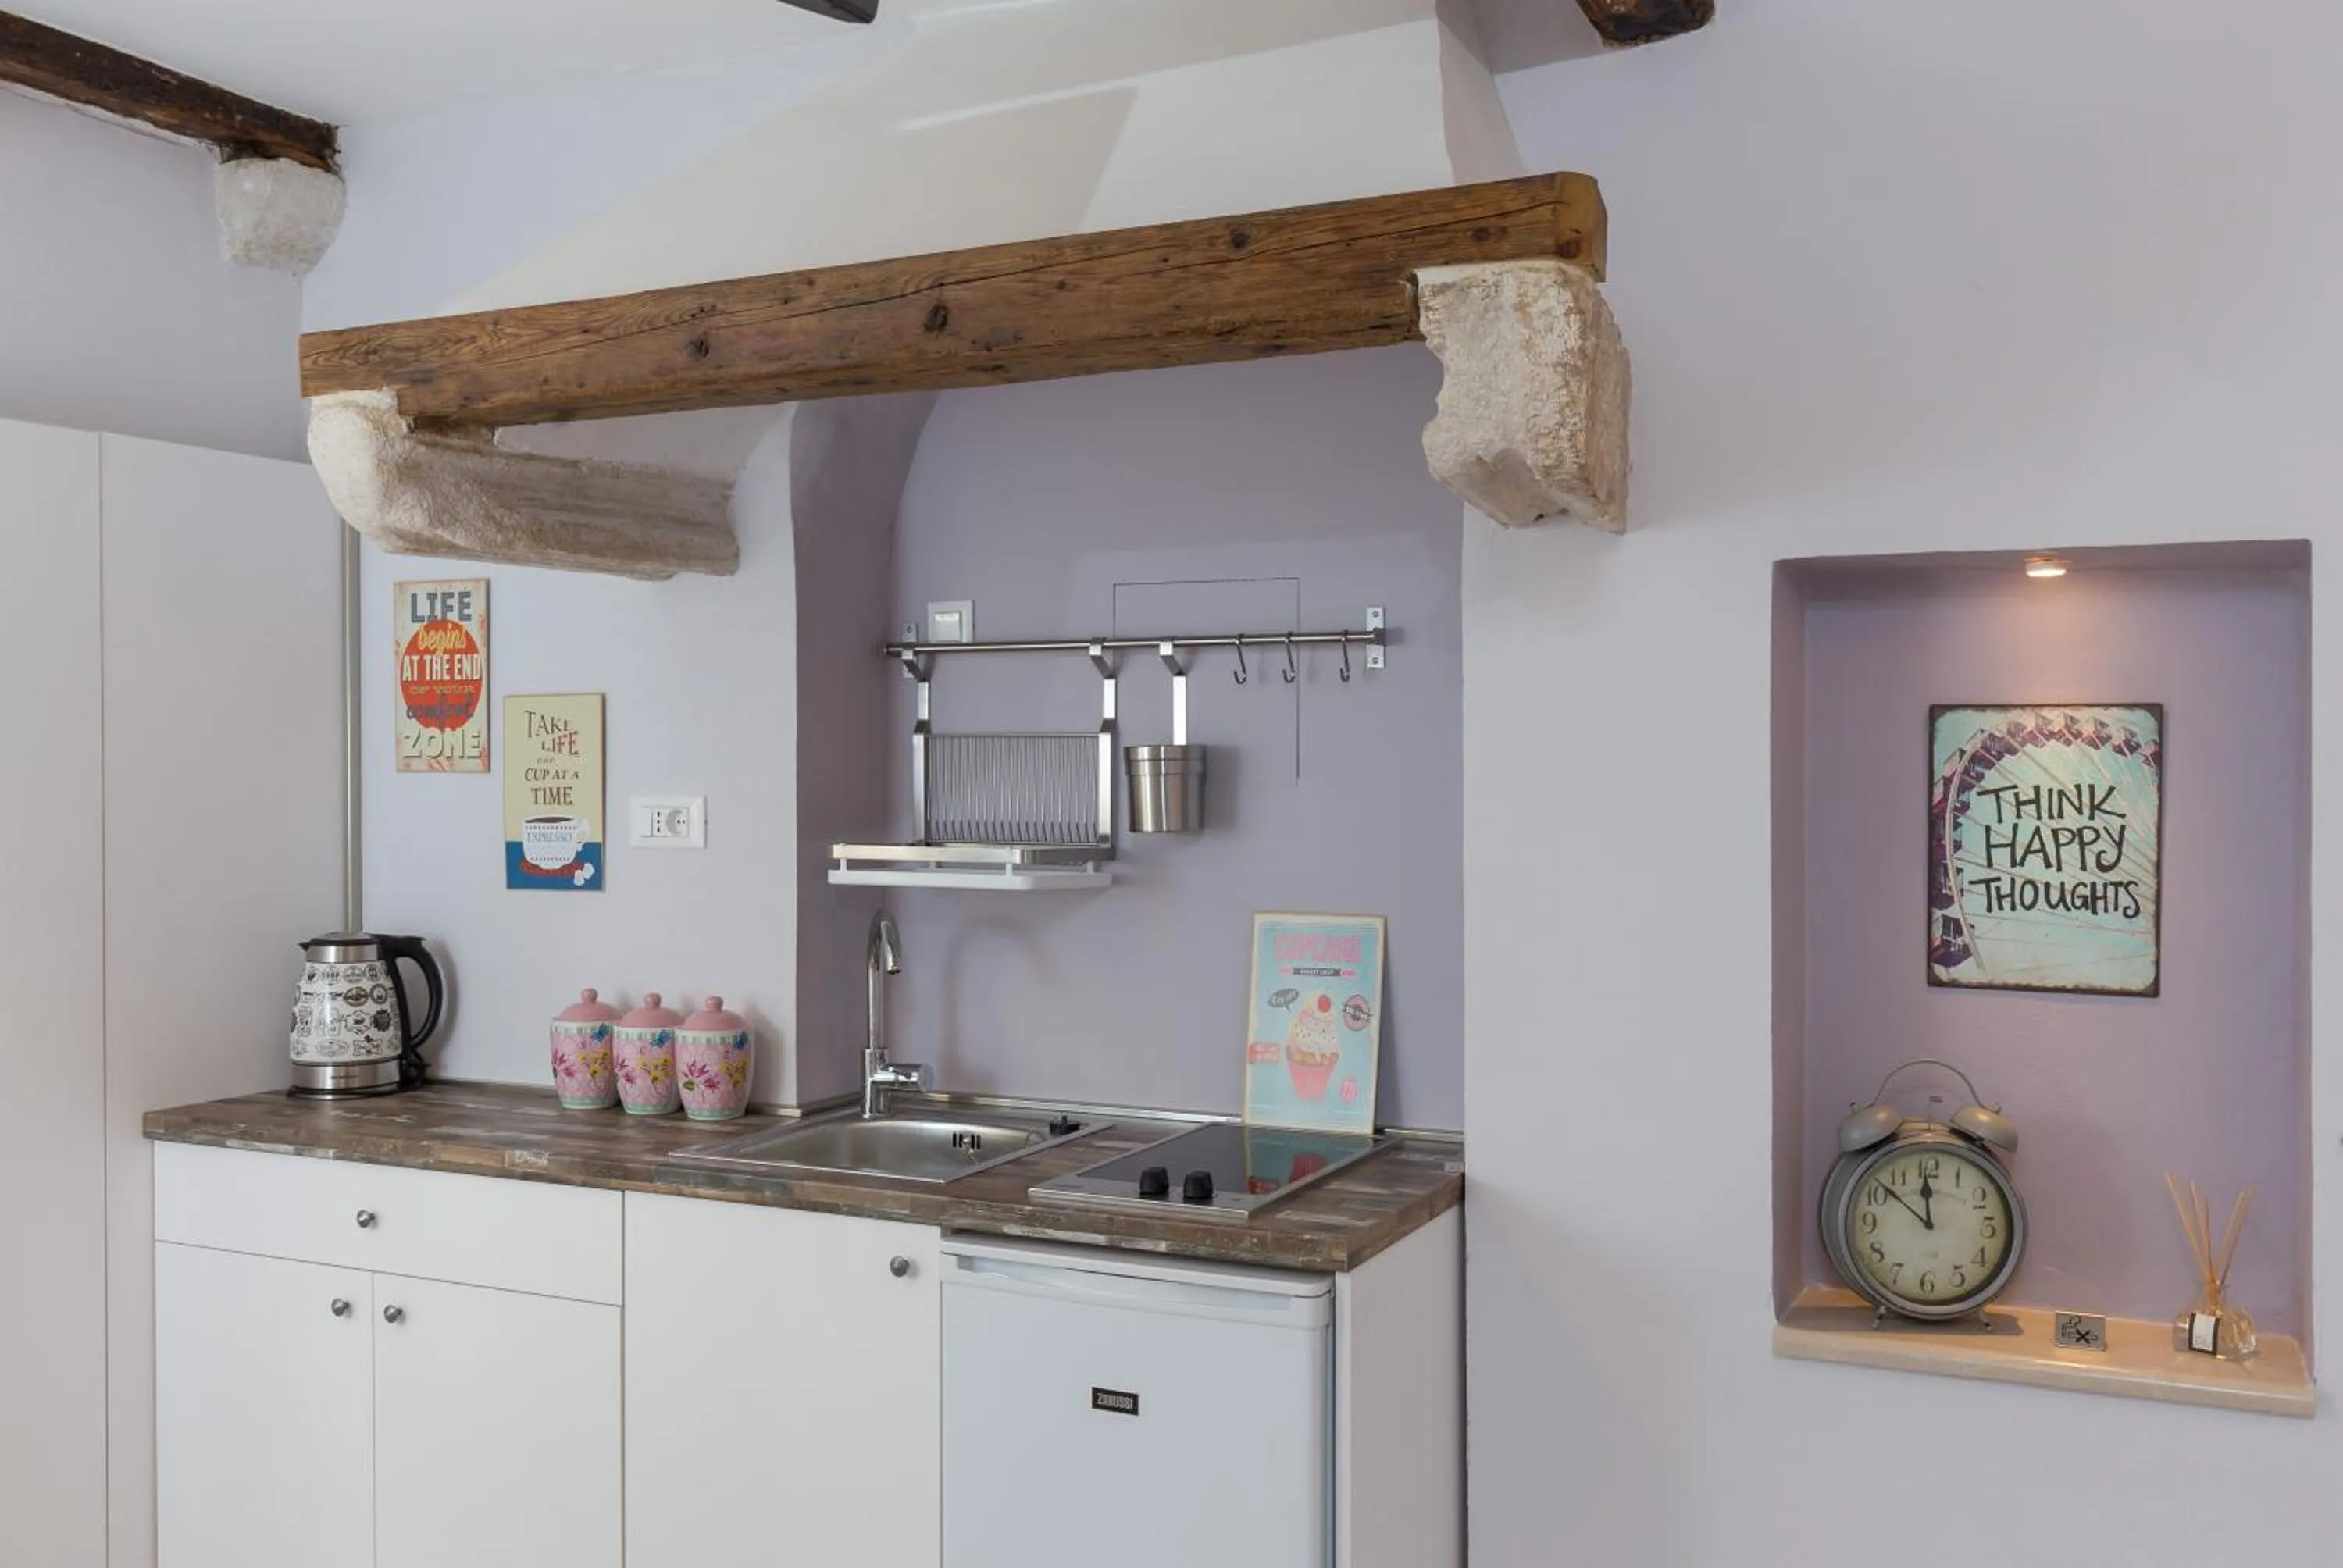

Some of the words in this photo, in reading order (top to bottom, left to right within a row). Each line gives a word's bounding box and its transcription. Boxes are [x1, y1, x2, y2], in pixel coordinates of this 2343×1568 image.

[411, 591, 473, 623] LIFE
[402, 654, 419, 682] AT
[423, 654, 451, 681] THE
[455, 653, 482, 680] END
[524, 710, 571, 738] TAKE
[401, 729, 482, 759] ZONE
[541, 730, 579, 755] LIFE
[524, 768, 549, 782] CUP
[531, 786, 572, 806] TIME
[1976, 784, 2127, 823] THINK
[1985, 822, 2127, 873] HAPPY
[1968, 877, 2141, 919] THOUGHTS
[1889, 1168, 1907, 1186] 11
[1918, 1156, 1939, 1179] 12
[1954, 1166, 1961, 1188] 1
[1866, 1187, 1888, 1206] 10
[1972, 1186, 1987, 1210] 2
[1861, 1212, 1878, 1235] 9
[1980, 1216, 1997, 1239] 3
[1870, 1242, 1885, 1263] 8
[1970, 1246, 1988, 1268] 4
[1888, 1263, 1904, 1285] 7
[1920, 1270, 1935, 1295] 6
[1949, 1265, 1966, 1288] 5
